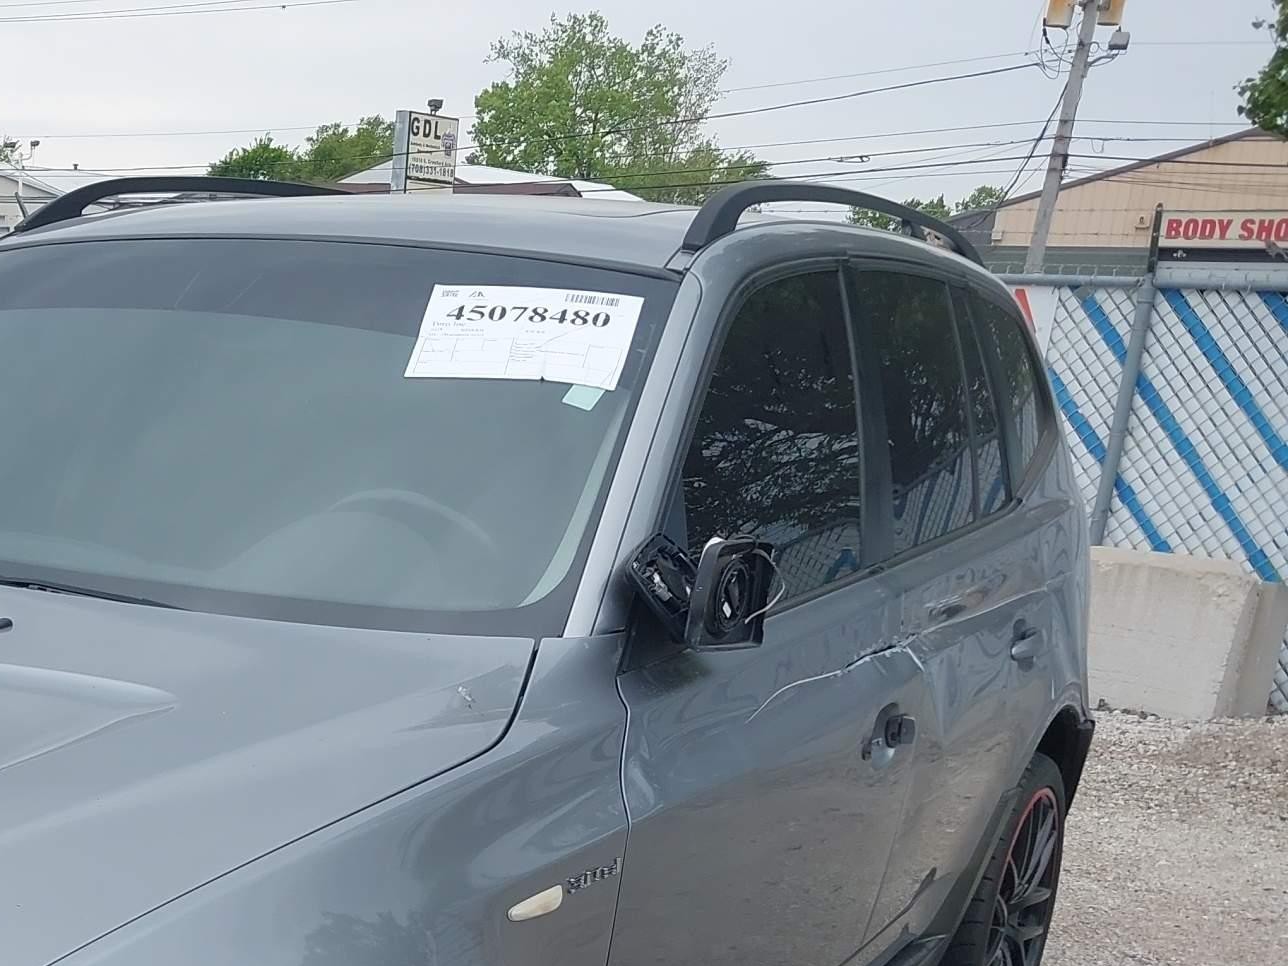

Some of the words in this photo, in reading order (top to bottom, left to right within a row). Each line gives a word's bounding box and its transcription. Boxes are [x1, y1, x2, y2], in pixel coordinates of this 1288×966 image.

[412, 117, 441, 139] GDL
[1165, 218, 1233, 240] BODY
[1239, 218, 1288, 241] SHO
[446, 304, 611, 328] 45078480
